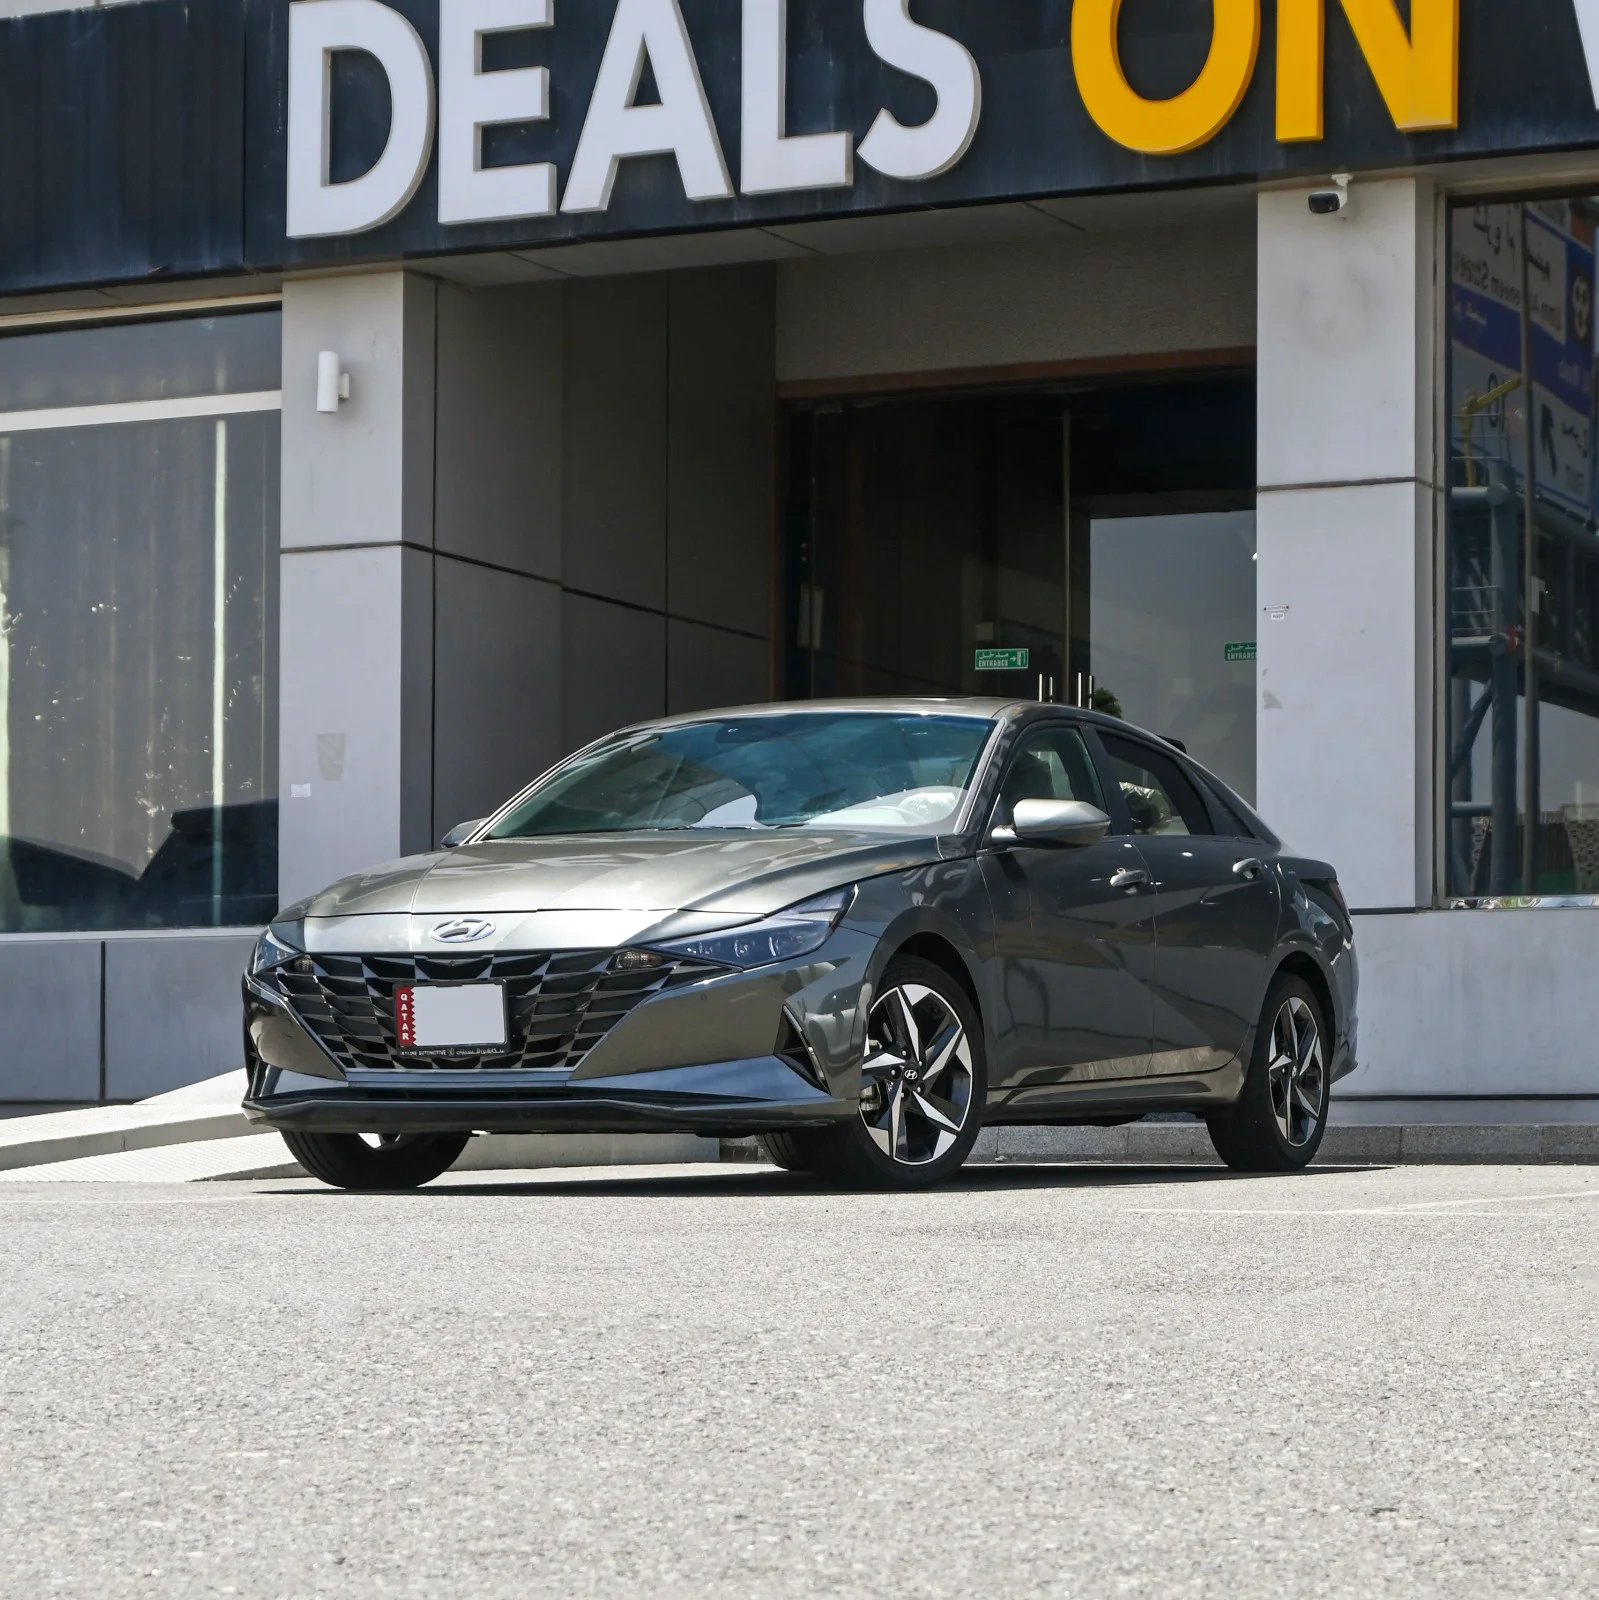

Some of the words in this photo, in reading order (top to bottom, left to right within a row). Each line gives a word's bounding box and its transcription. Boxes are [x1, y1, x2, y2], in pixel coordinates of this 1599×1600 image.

[286, 0, 982, 238] DEALS
[1071, 0, 1459, 155] ON
[1227, 643, 1257, 652] دخل
[978, 658, 1009, 667] ENTRANCE
[400, 993, 409, 1041] QATAR
